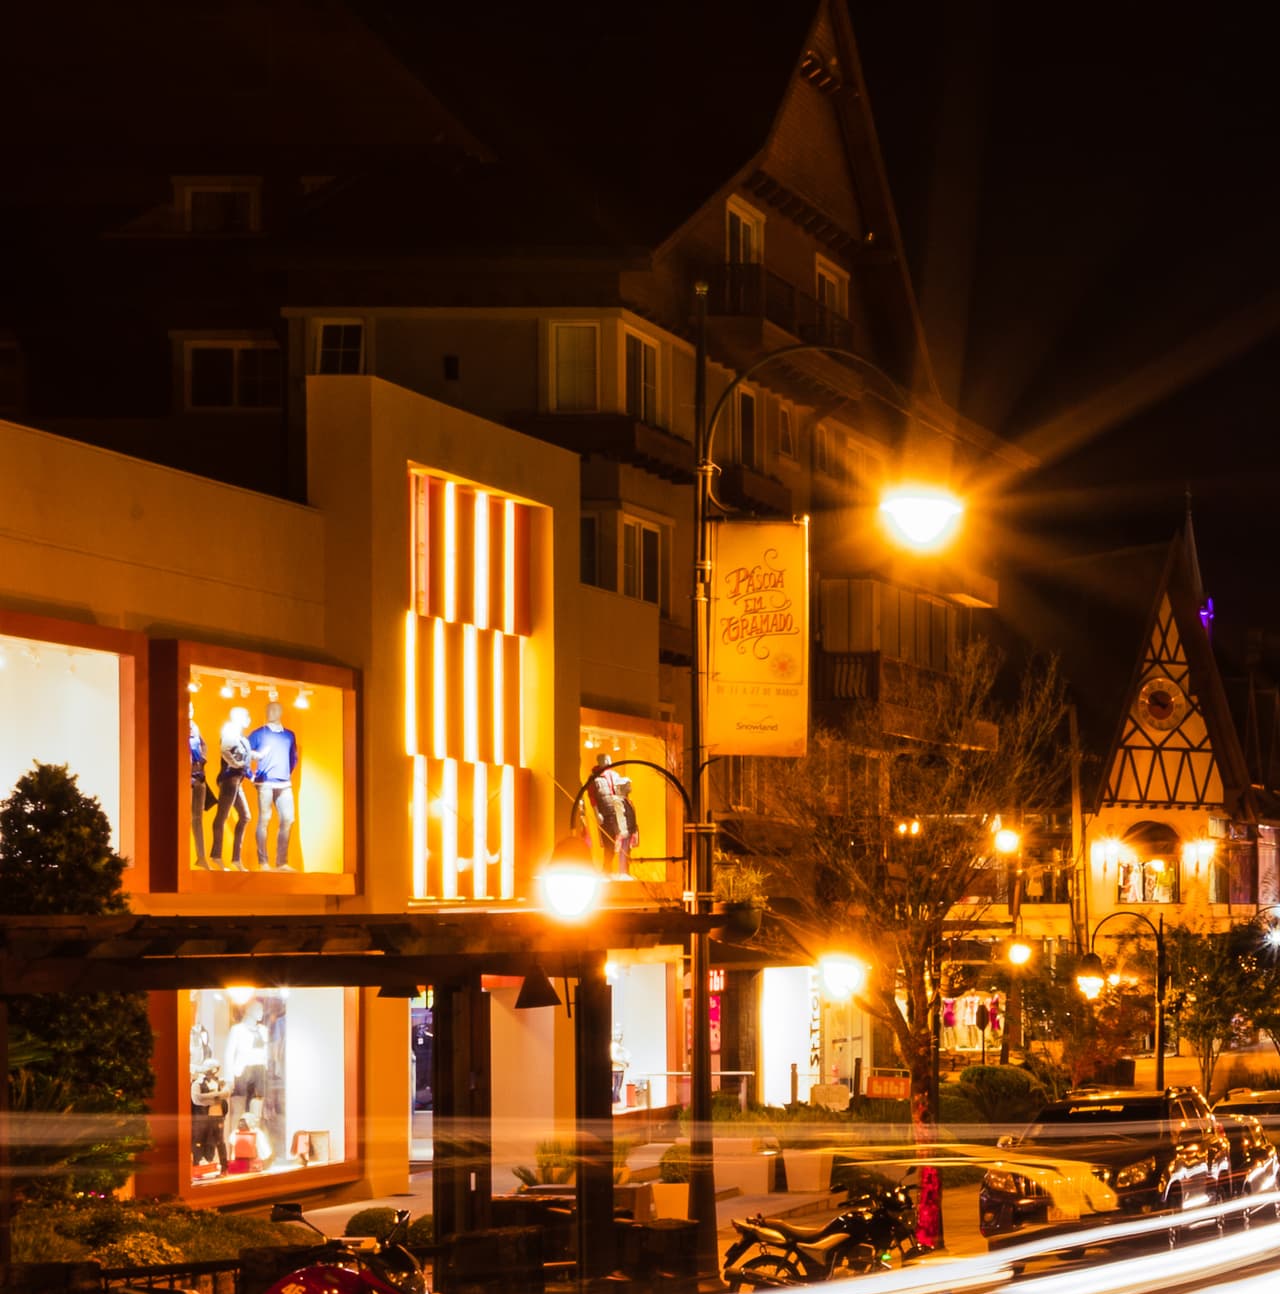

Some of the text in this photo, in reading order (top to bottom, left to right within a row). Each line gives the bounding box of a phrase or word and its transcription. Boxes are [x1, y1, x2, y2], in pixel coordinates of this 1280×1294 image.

[720, 613, 794, 642] GRAMADO
[736, 721, 778, 732] Snowland
[872, 1080, 905, 1095] bibi
